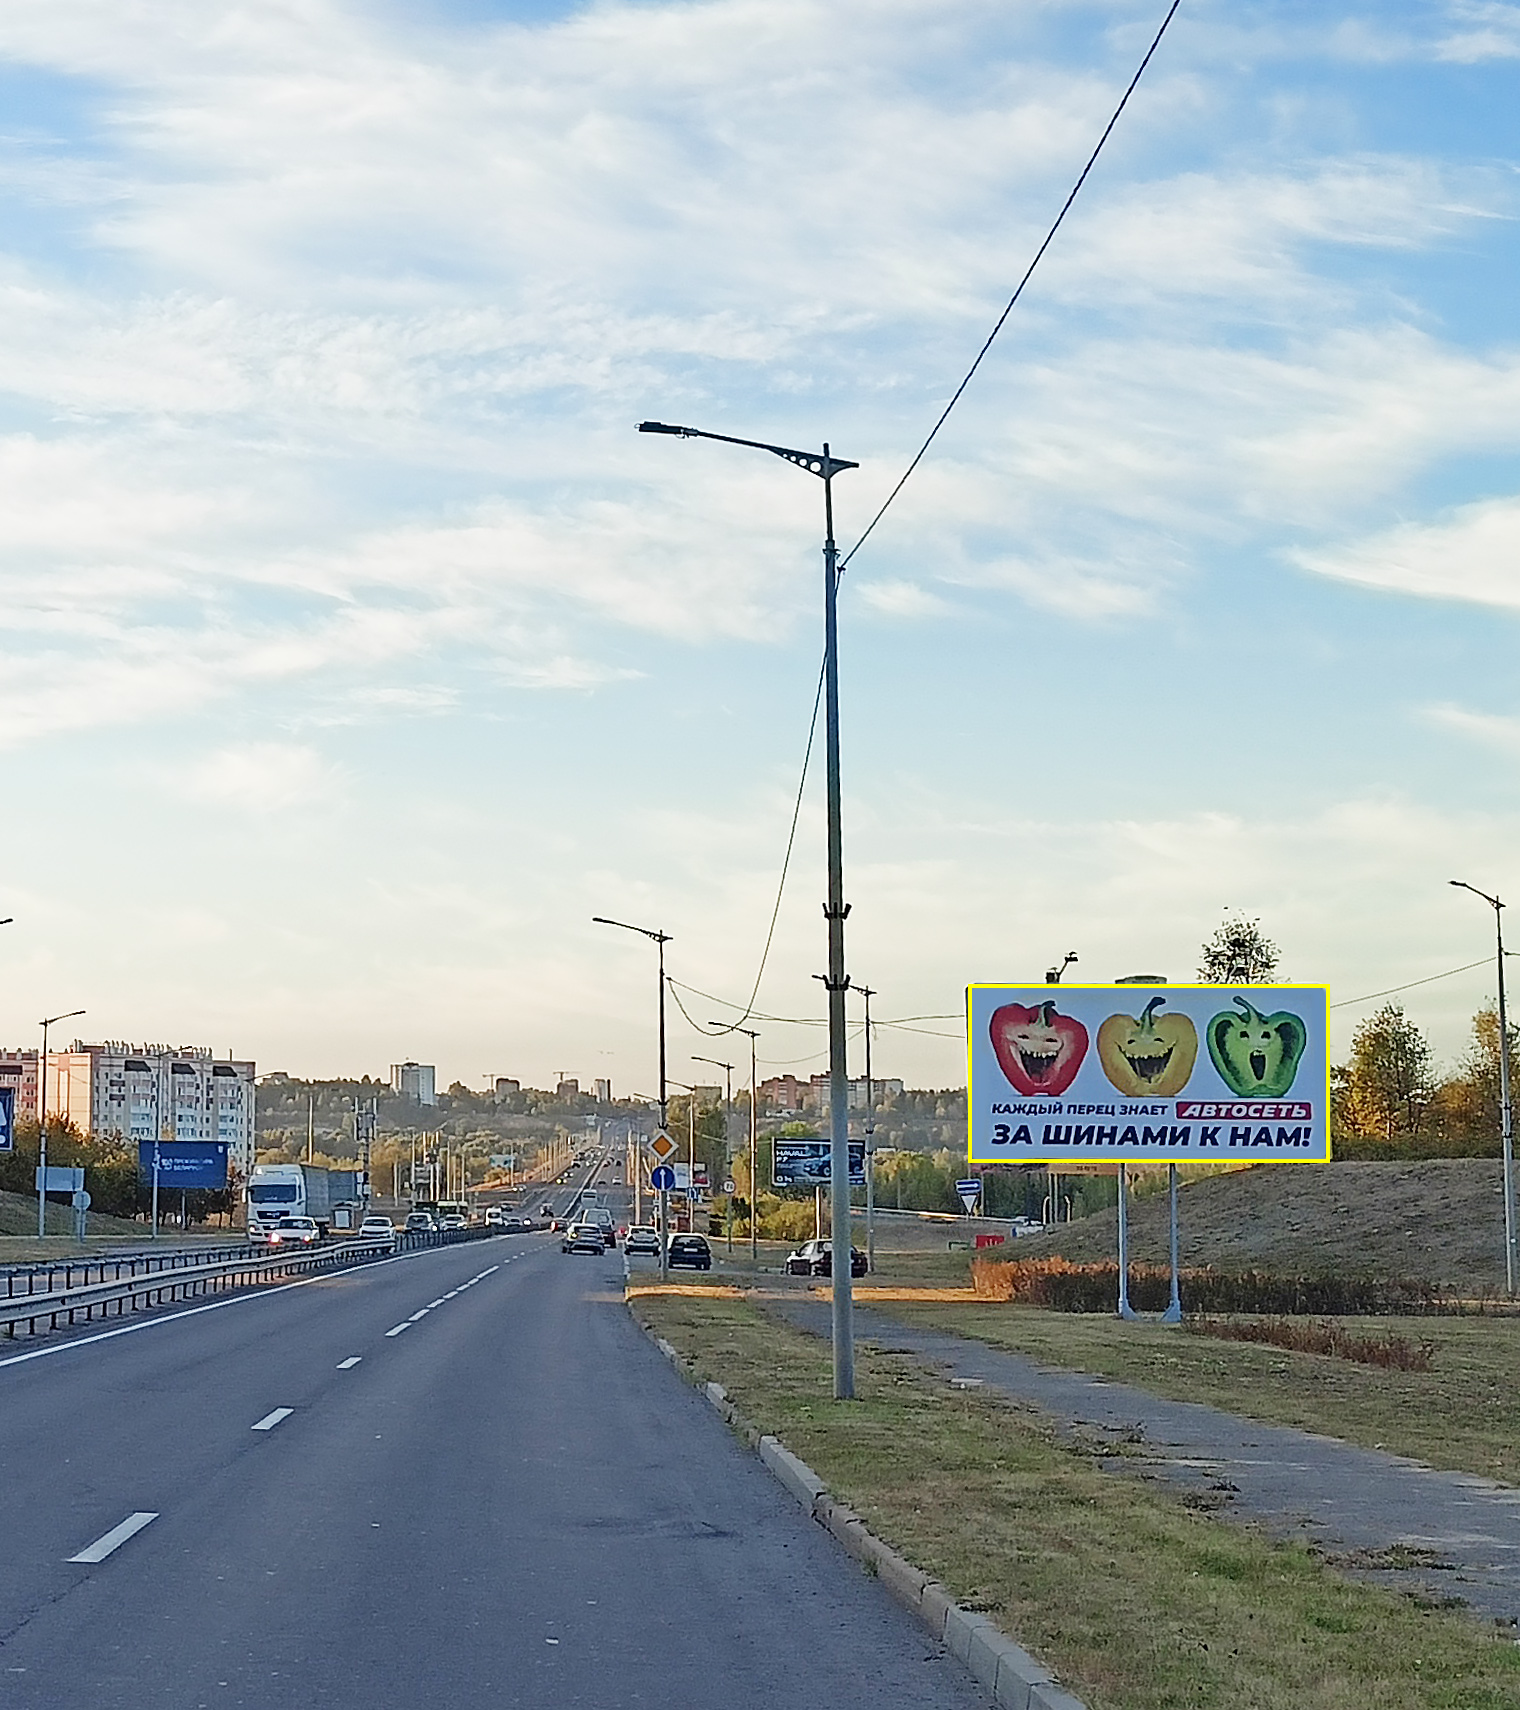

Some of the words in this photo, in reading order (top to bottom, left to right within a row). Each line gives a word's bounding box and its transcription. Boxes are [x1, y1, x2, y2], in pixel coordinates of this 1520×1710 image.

[991, 1102, 1063, 1116] КАЖДЫЙ
[1066, 1104, 1115, 1116] ПЕРЕЦ
[1119, 1104, 1168, 1116] ЗНАЕТ
[1181, 1104, 1307, 1118] АВТОСЕТЬ
[991, 1123, 1032, 1145] ЗА
[1042, 1124, 1191, 1146] ШИНАМИ
[1199, 1126, 1221, 1147] К
[1229, 1126, 1312, 1147] НАМ!
